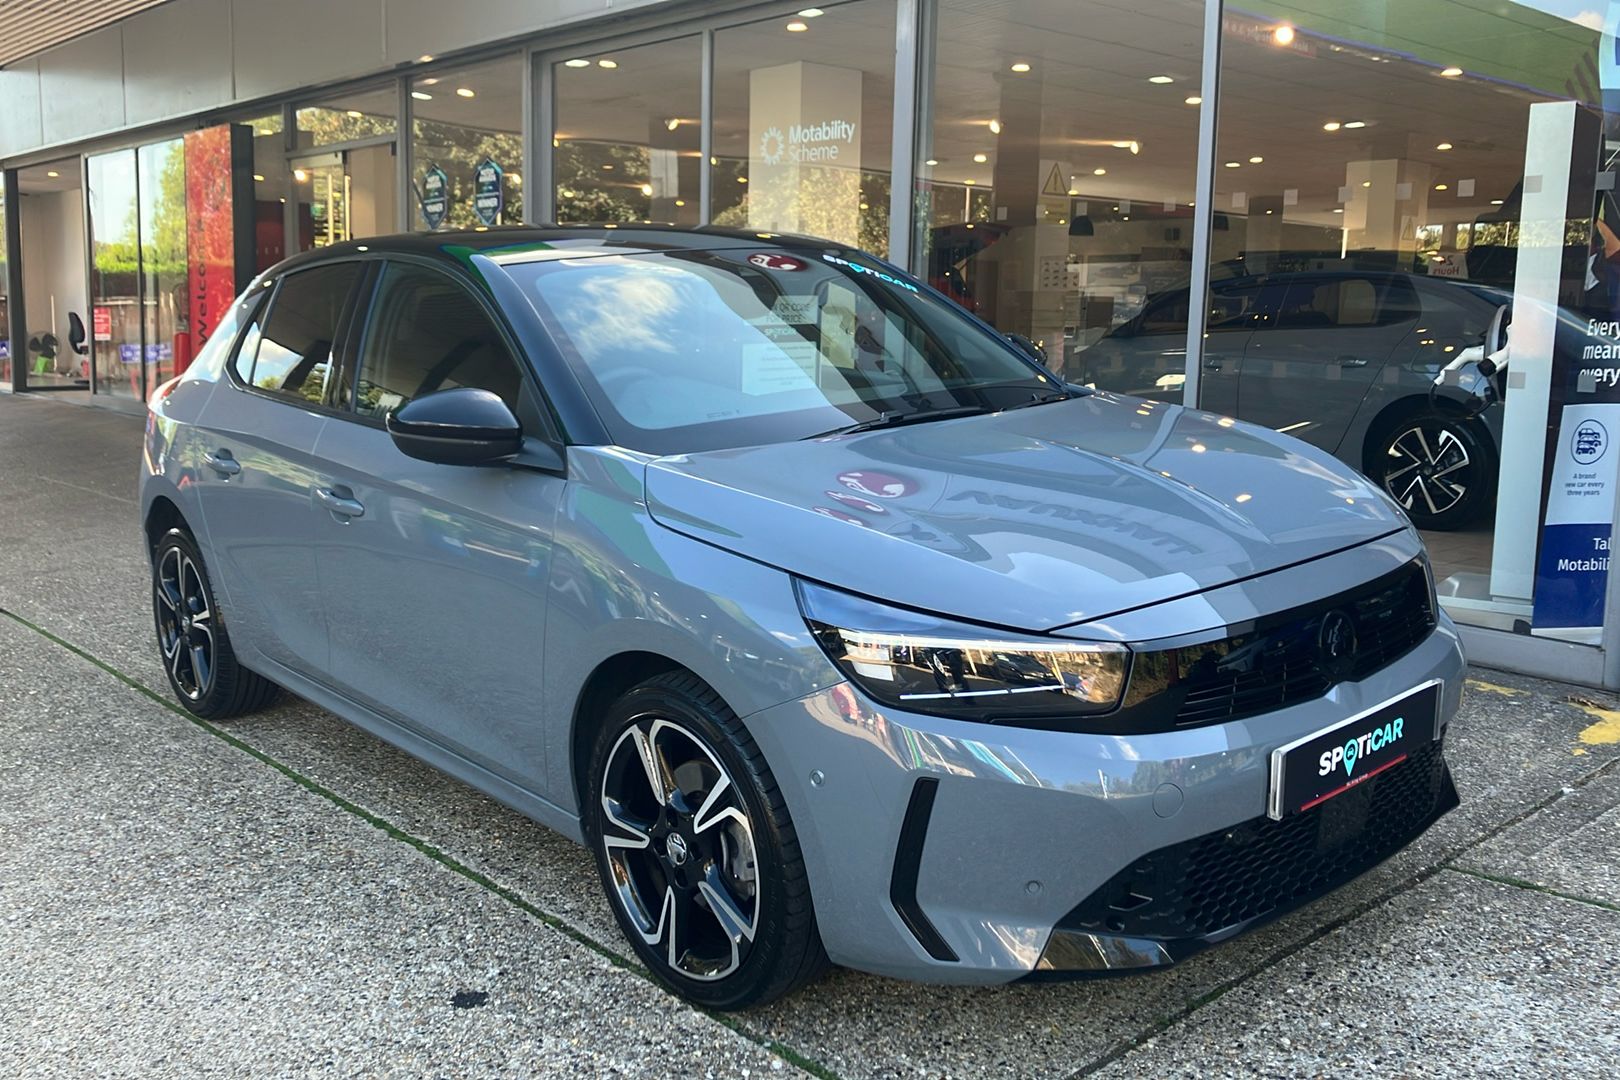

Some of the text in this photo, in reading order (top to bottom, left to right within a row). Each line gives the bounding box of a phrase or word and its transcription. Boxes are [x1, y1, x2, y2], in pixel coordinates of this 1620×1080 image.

[788, 119, 855, 144] Motability
[788, 144, 839, 161] Scheme
[1587, 318, 1620, 340] Every
